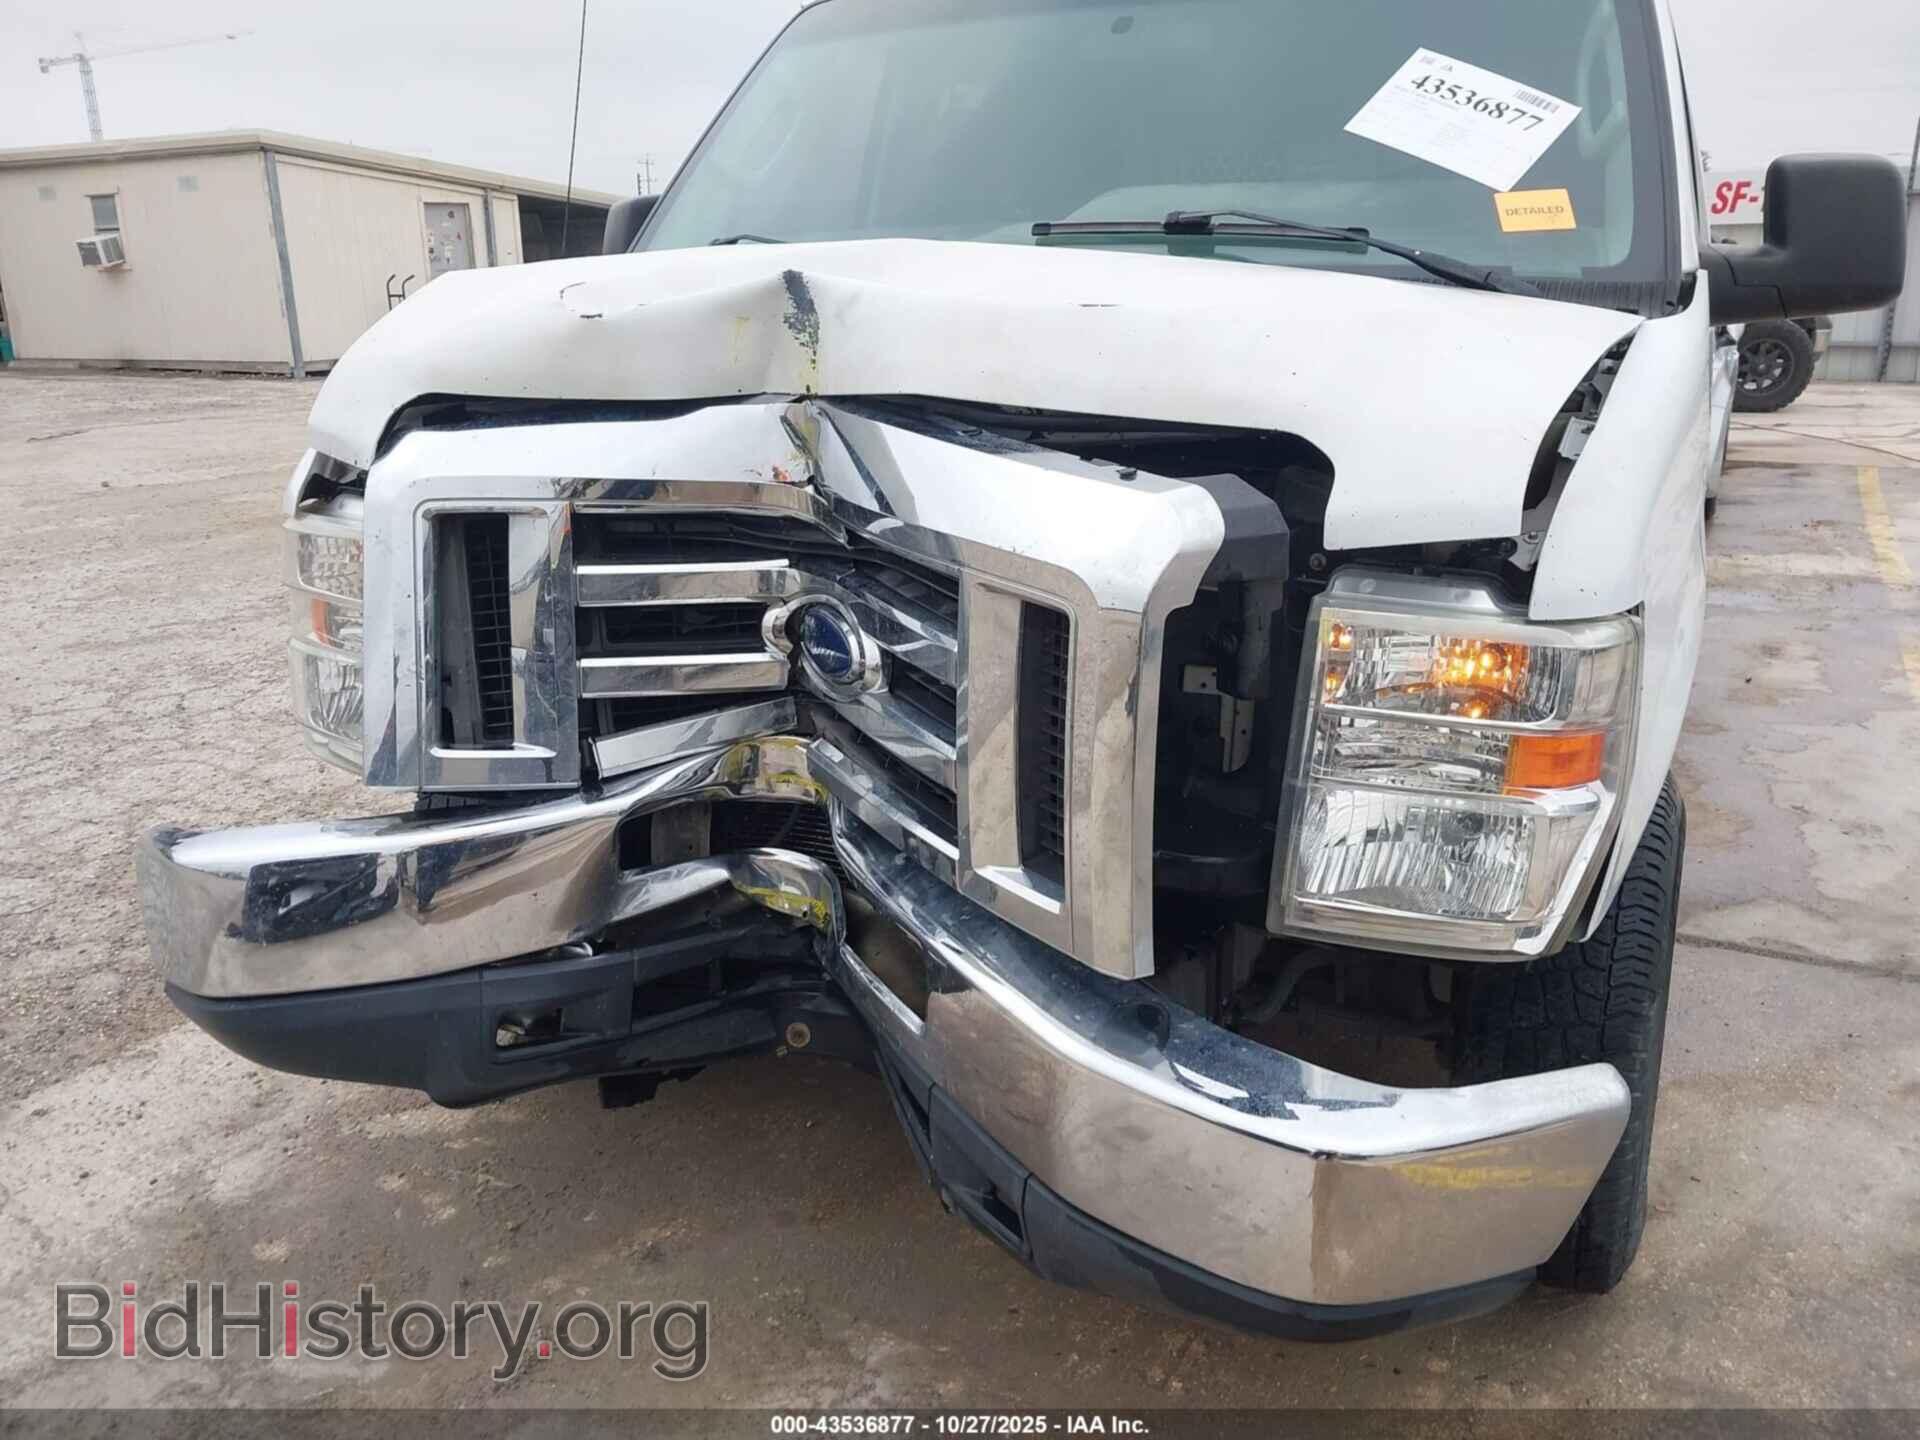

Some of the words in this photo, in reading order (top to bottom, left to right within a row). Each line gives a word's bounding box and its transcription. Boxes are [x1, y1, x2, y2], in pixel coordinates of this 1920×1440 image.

[1411, 75, 1544, 131] 43536877
[1505, 206, 1564, 216] DETAILED
[1711, 181, 1763, 214] SF-
